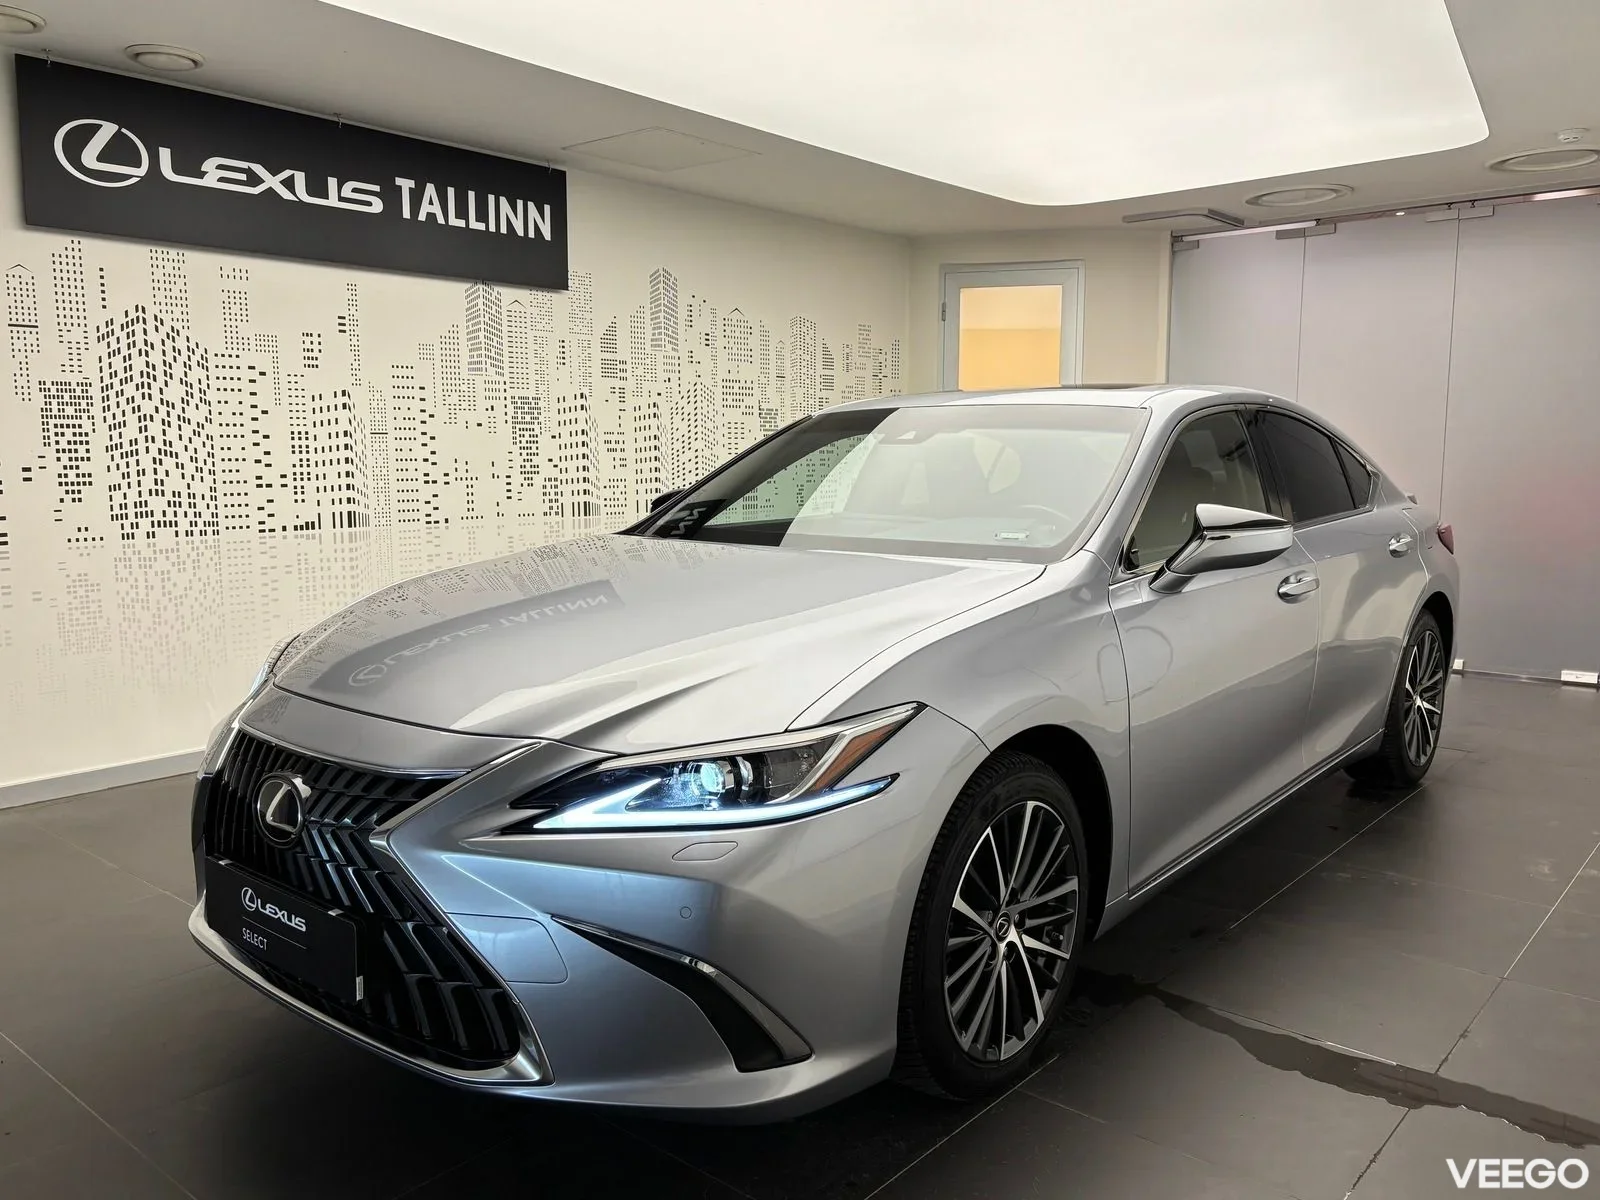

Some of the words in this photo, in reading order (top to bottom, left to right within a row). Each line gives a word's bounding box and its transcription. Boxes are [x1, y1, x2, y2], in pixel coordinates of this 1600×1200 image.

[159, 146, 384, 214] LEXUS
[395, 177, 552, 242] TALLINN
[257, 898, 307, 932] LEXUS
[242, 927, 268, 951] SELECT
